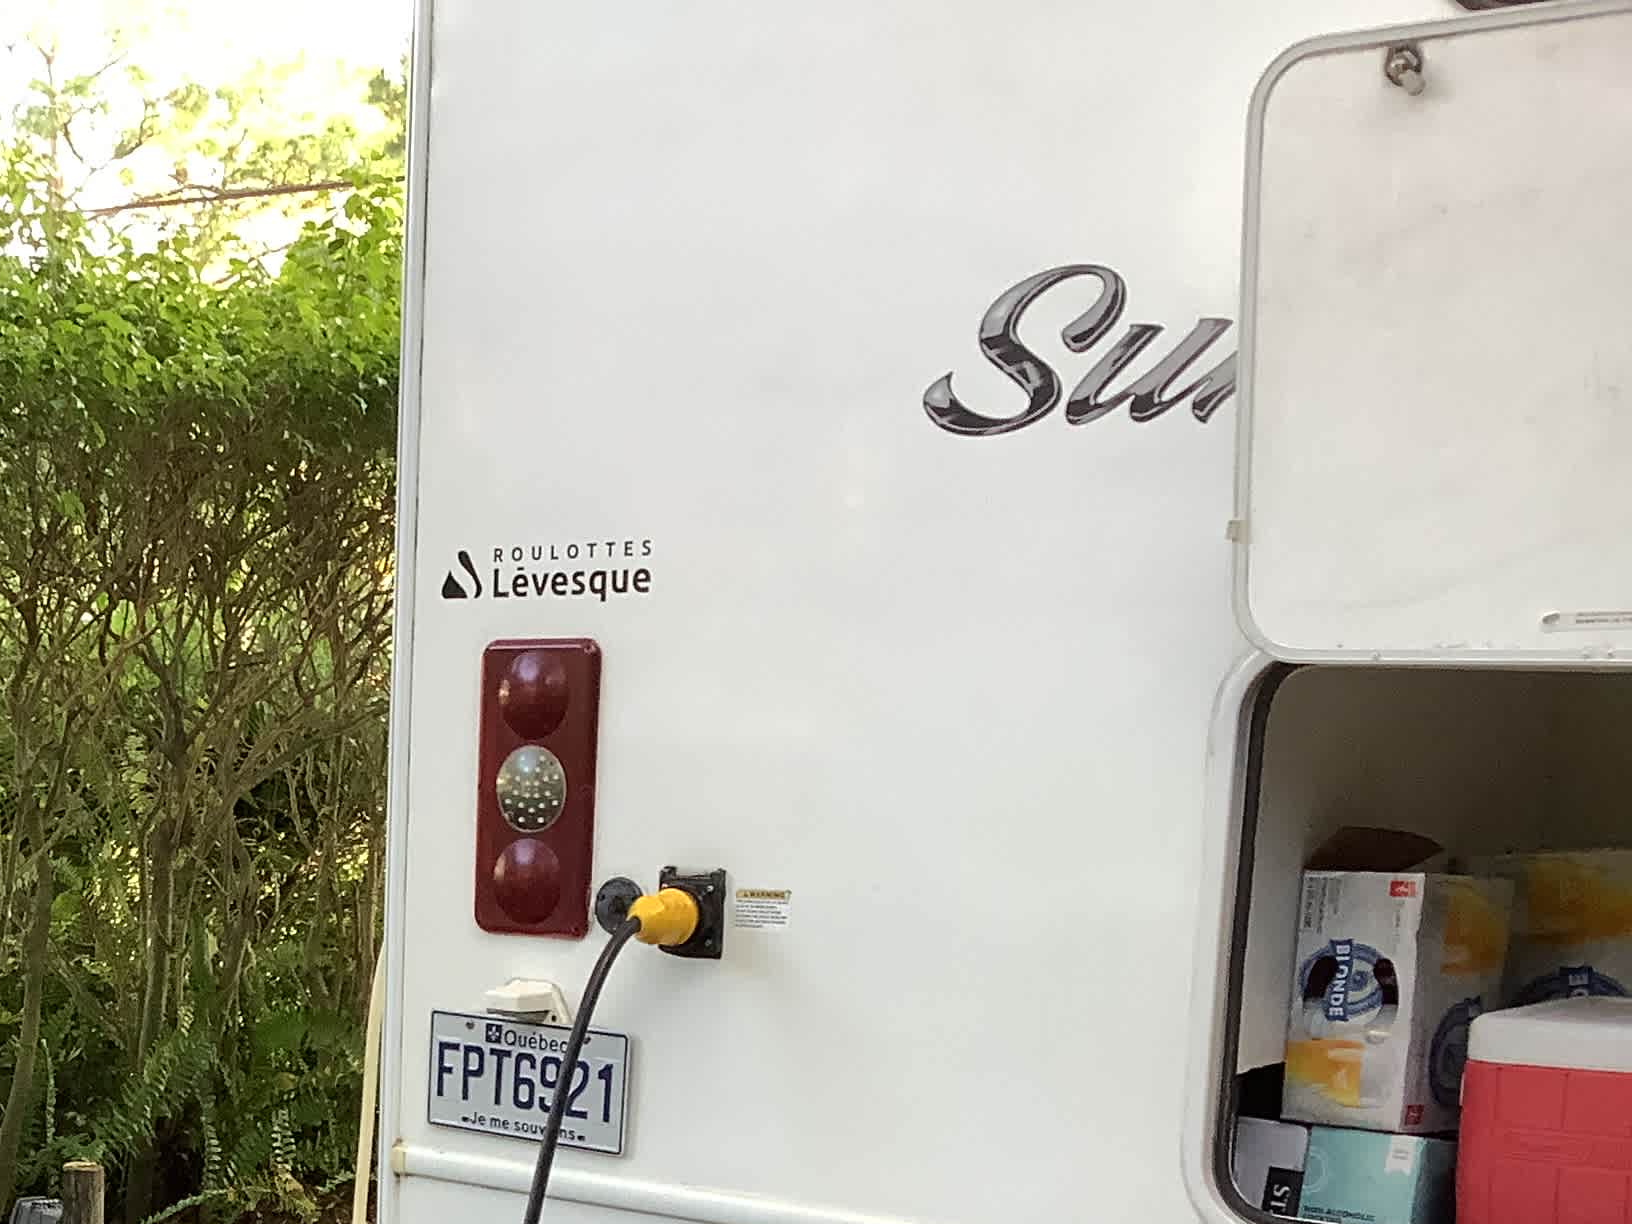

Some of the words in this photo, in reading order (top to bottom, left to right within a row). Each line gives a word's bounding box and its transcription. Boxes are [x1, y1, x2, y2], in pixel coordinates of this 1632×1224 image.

[493, 540, 652, 562] ROULOTTES
[493, 566, 652, 602] Lévesque
[1328, 945, 1351, 1017] BLONDE
[504, 1030, 568, 1053] Québec
[437, 1041, 614, 1123] FPT6921
[470, 1112, 486, 1126] Je
[490, 1117, 510, 1130] me
[514, 1121, 576, 1141] souvns
